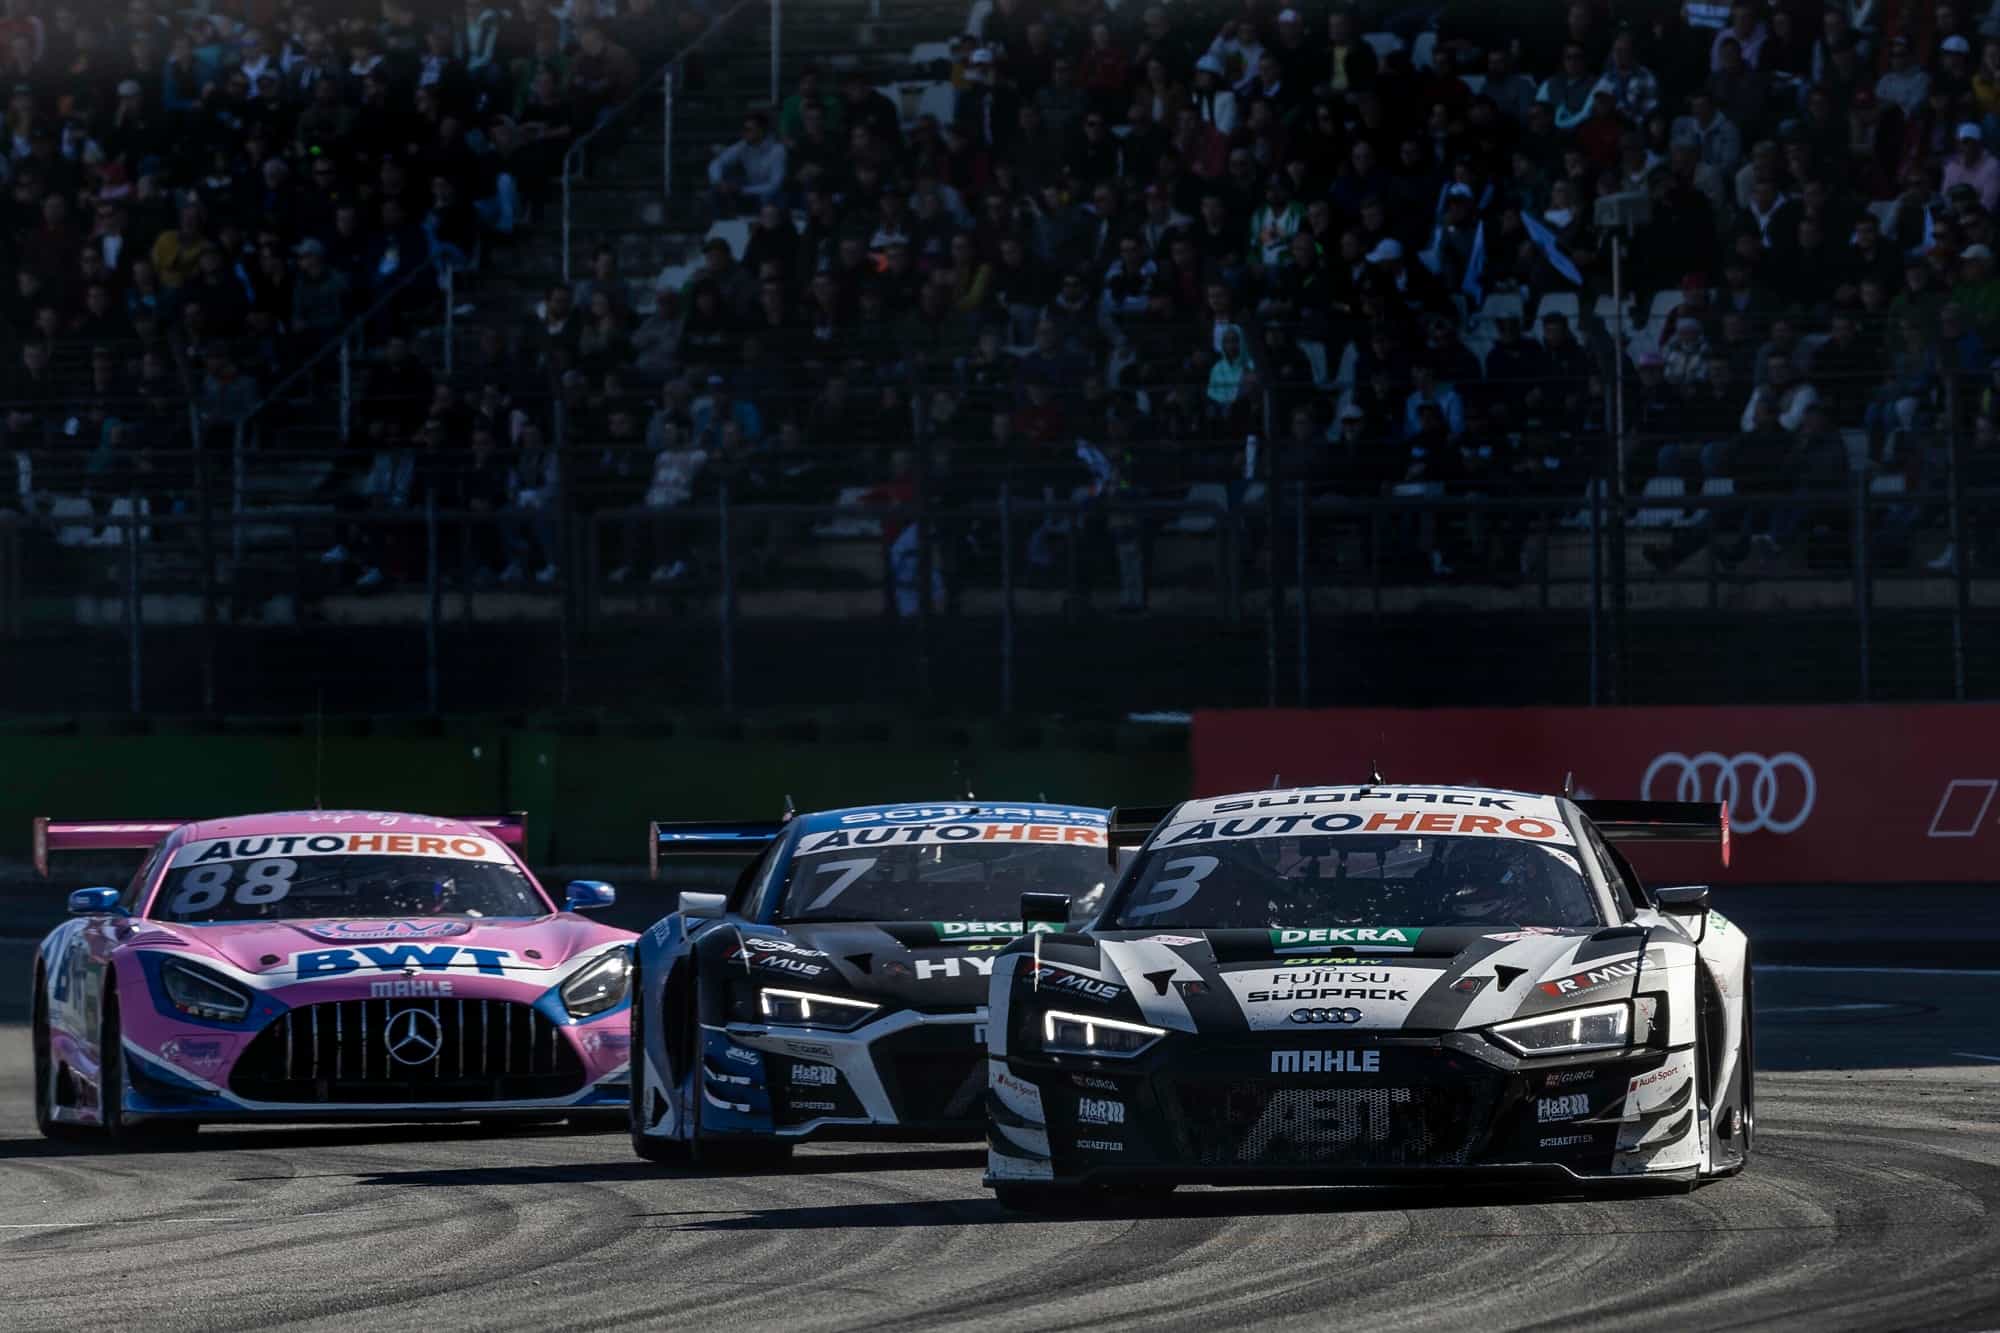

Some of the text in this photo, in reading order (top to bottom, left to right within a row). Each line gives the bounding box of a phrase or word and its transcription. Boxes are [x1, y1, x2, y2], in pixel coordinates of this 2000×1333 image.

[808, 823, 1109, 852] AUTOHER
[1177, 811, 1557, 845] AUTOHERO
[194, 834, 486, 863] AUTOHERO
[171, 857, 299, 914] 88
[806, 858, 878, 912] 7
[1128, 855, 1220, 918] 3
[1280, 928, 1408, 944] DEKRA
[296, 944, 513, 980] BWT
[1282, 957, 1358, 966] DTM
[1273, 964, 1391, 986] FUJITSU
[369, 979, 453, 997] MAHLE
[1246, 987, 1408, 1003] SÜDPACK
[1270, 1048, 1381, 1073] MAHLE
[1639, 1066, 1680, 1086] Audi Sport
[1078, 1096, 1106, 1119] H&R
[1537, 1095, 1571, 1118] H&R
[1538, 1134, 1594, 1149] SCHAEFFLER
